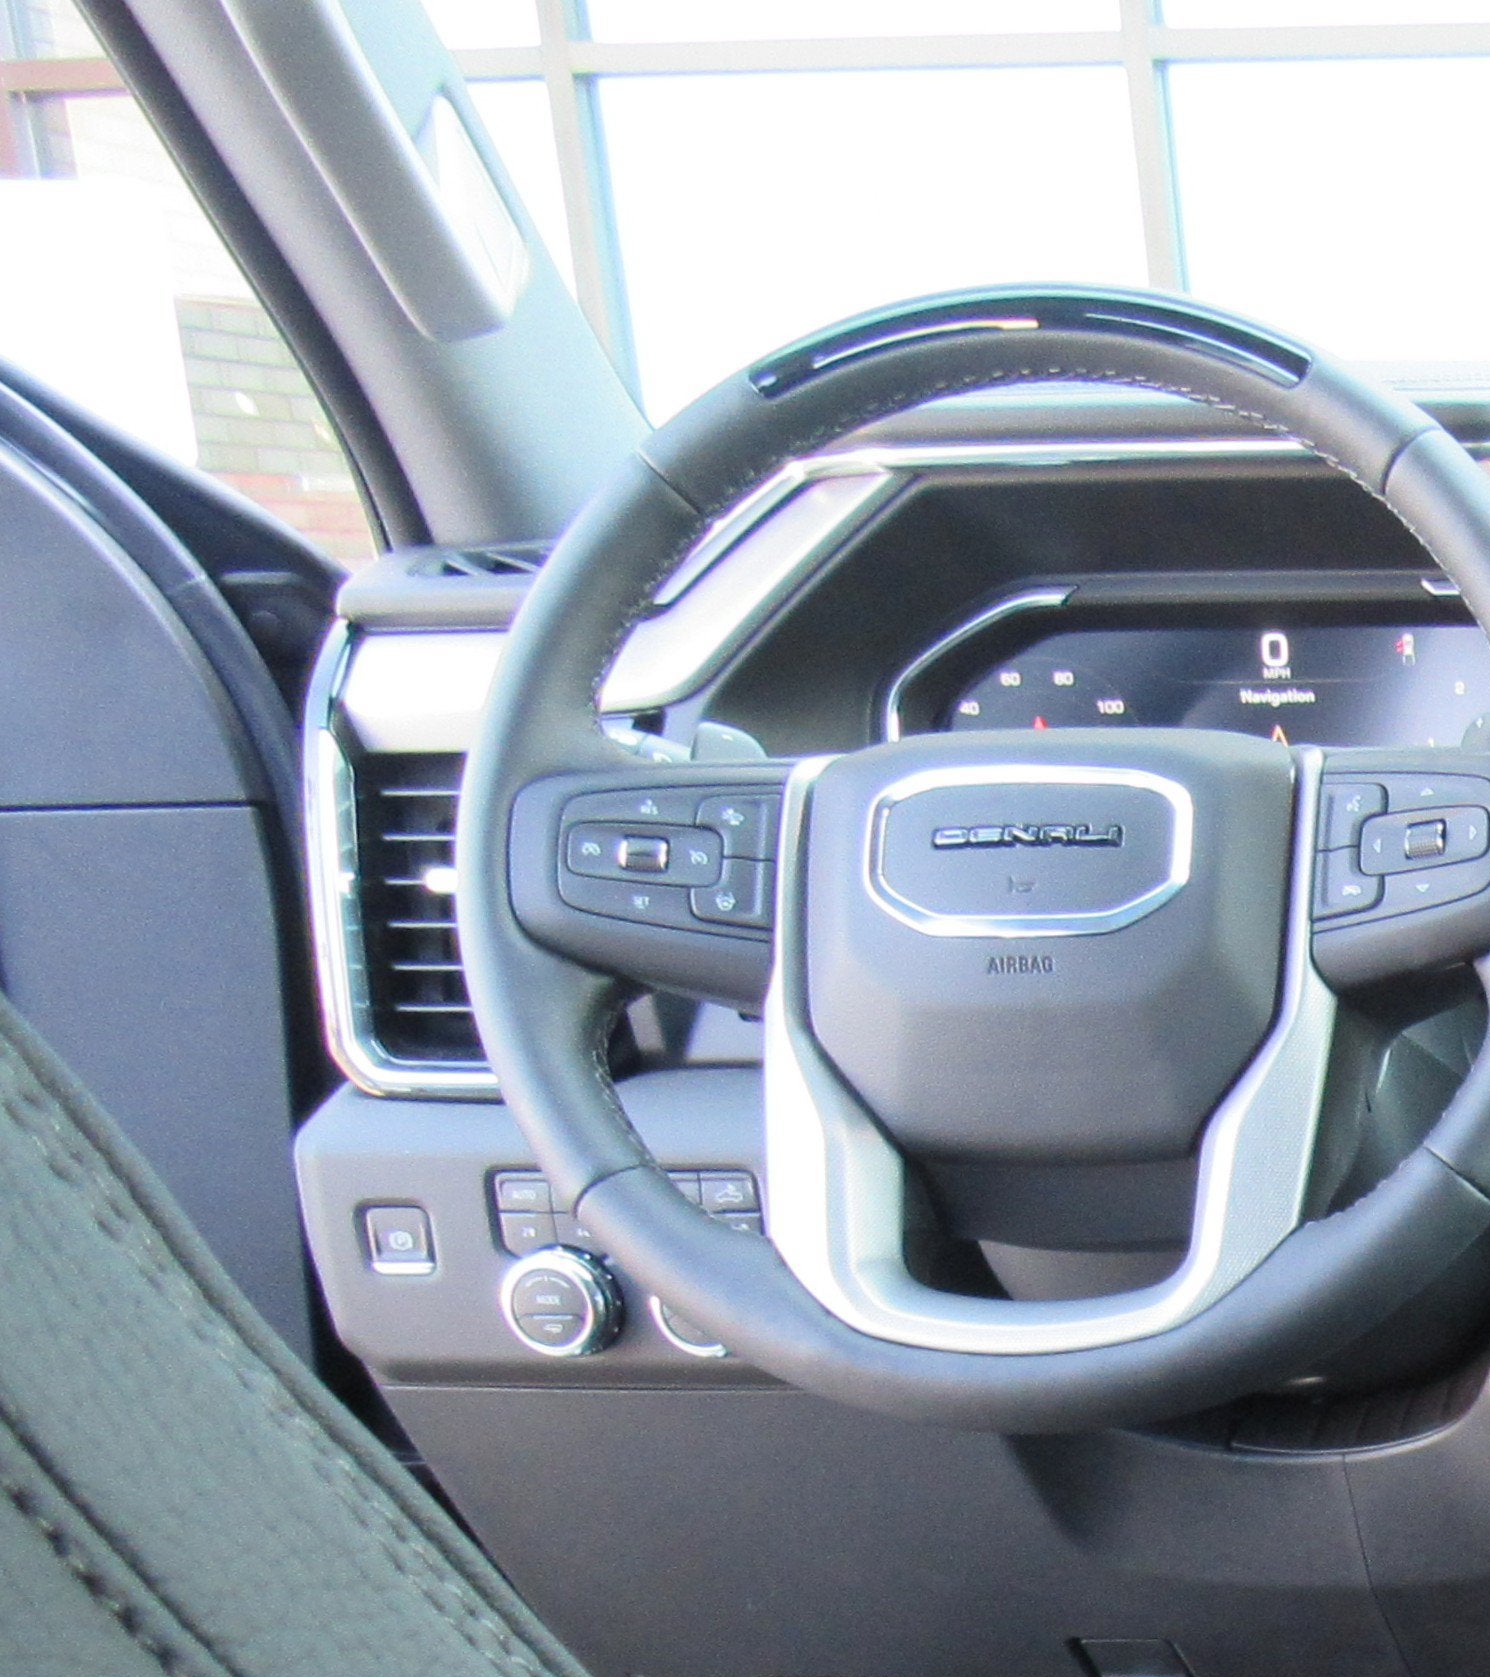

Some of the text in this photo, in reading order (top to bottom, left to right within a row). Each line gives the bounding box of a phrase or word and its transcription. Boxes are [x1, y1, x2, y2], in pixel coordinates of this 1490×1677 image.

[1261, 632, 1288, 667] 0
[1263, 667, 1291, 679] MPH
[1097, 700, 1125, 715] 100
[1240, 688, 1316, 708] Navigation
[933, 823, 1126, 850] DENALI
[986, 955, 1054, 976] AIRBAG
